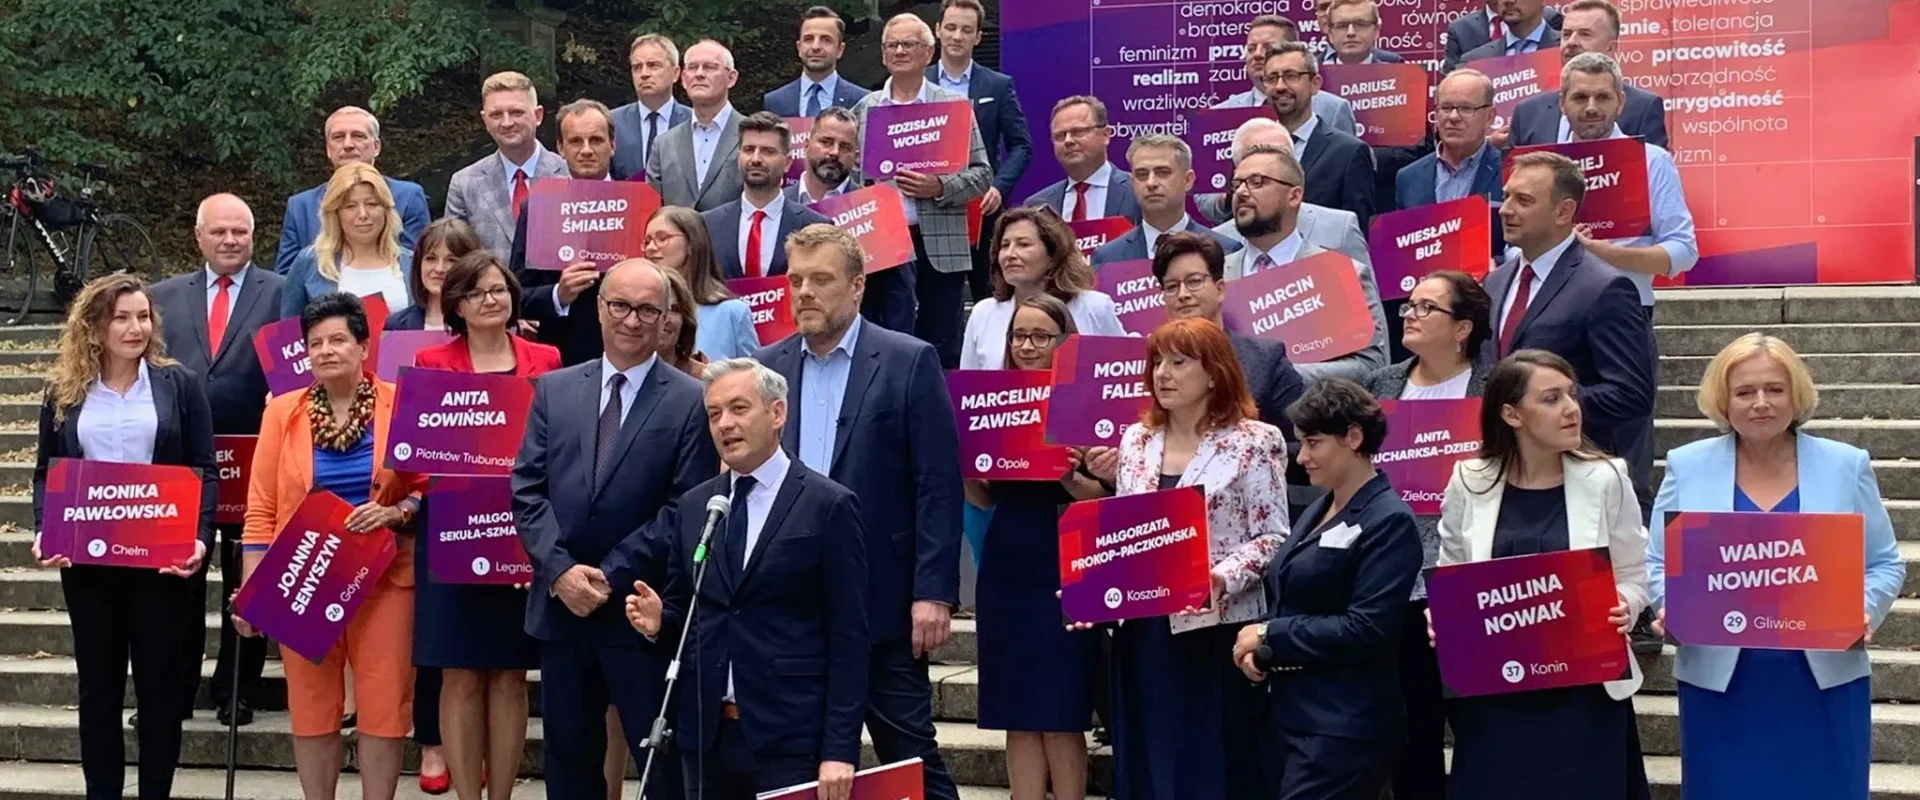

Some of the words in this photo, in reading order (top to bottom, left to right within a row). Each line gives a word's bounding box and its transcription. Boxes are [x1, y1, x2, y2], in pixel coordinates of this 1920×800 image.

[1180, 0, 1290, 17] demokracja
[1672, 11, 1774, 33] tolerancja
[1119, 45, 1197, 62] feminizm
[1652, 39, 1786, 66] pracowitość
[1133, 69, 1199, 86] realizm
[1492, 68, 1538, 89] PAWEŁ
[1341, 79, 1397, 96] DARIUSZ
[1123, 92, 1220, 111] wrażliwość
[887, 115, 948, 136] ZDZISŁAW
[1682, 115, 1788, 137] wspólnota
[892, 131, 941, 149] WOLSKI
[560, 199, 628, 215] RYSZARD
[562, 217, 625, 233] ŚMIAŁEK
[1396, 217, 1462, 248] WIESŁAW
[1415, 239, 1443, 261] BUŻ
[1249, 275, 1315, 314] MARCIN
[1252, 293, 1324, 336] KULASEK
[1291, 336, 1333, 355] Olsztyn
[441, 391, 490, 406] ANITA
[961, 385, 1050, 410] MARCELINA
[417, 409, 507, 428] SOWIŃSKA
[968, 409, 1042, 431] ZAWISZA
[1414, 430, 1451, 444] ANITA
[216, 449, 235, 463] EK
[416, 447, 460, 462] Piotrków
[996, 457, 1030, 470] Opole
[87, 483, 159, 500] MONIKA
[63, 503, 178, 522] PAWŁOWSKA
[439, 526, 518, 543] SEKUŁA-SZMA
[1095, 517, 1170, 549] MAŁGORZATA
[1071, 526, 1197, 572] PROKOP-PACZKOWSKA
[1719, 538, 1806, 563] WANDA
[277, 529, 321, 598] JOANNA
[495, 561, 534, 575] Legnic
[290, 533, 342, 616] SENYSZYN
[1708, 565, 1819, 592] NOWICKA
[340, 566, 370, 603] Gdynia
[1126, 586, 1171, 602] Koszalin
[1476, 573, 1564, 610] PAULINA
[1484, 600, 1566, 636] NOWAK
[1753, 616, 1807, 631] Gliwice
[1530, 660, 1569, 676] Konin
